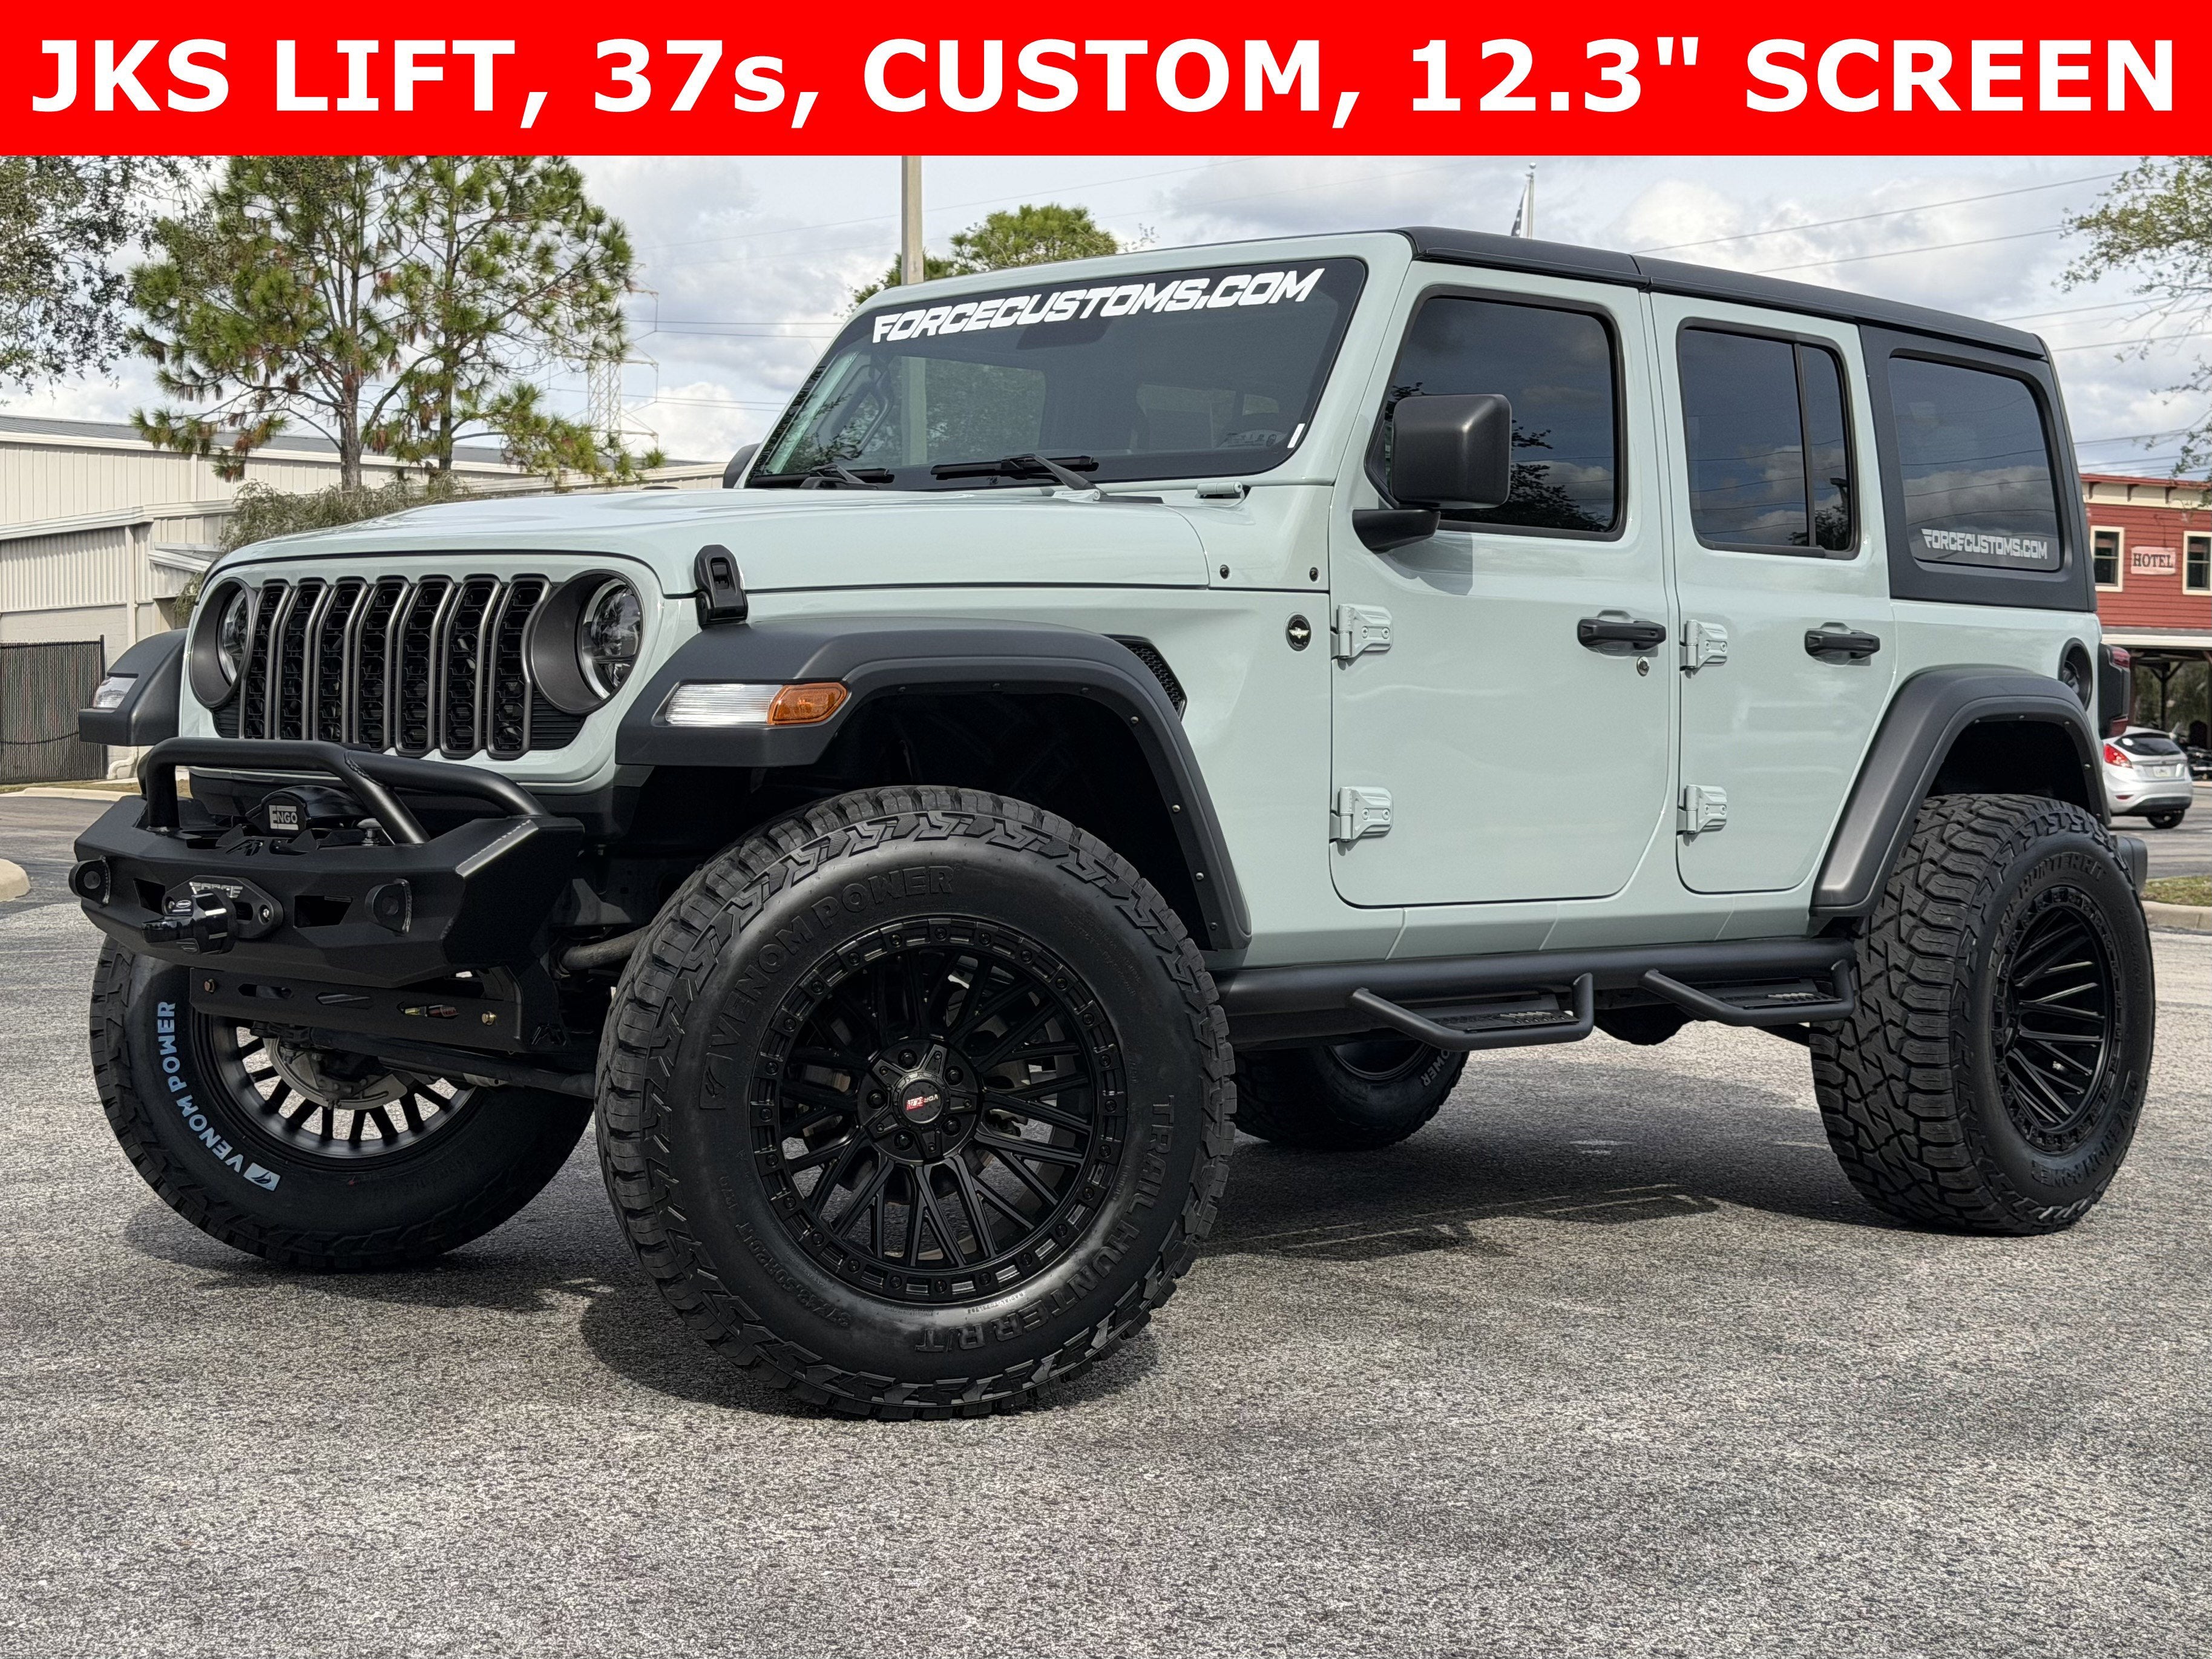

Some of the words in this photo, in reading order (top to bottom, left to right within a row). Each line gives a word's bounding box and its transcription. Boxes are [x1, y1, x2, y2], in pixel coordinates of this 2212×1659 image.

[873, 267, 1326, 344] FORCECUSTOMS.COM
[1920, 528, 2048, 560] FORCECUSTOMS.COM
[2133, 553, 2174, 568] HOTEL
[268, 804, 299, 831] ENGO
[707, 915, 814, 1048] VENOM
[811, 865, 954, 930] POWER
[157, 1001, 188, 1093] POWER
[1420, 1049, 1450, 1086] OWER
[176, 1094, 244, 1173] VENOM
[1127, 1094, 1175, 1215] TRAIL
[991, 1219, 1141, 1342] HUNTER
